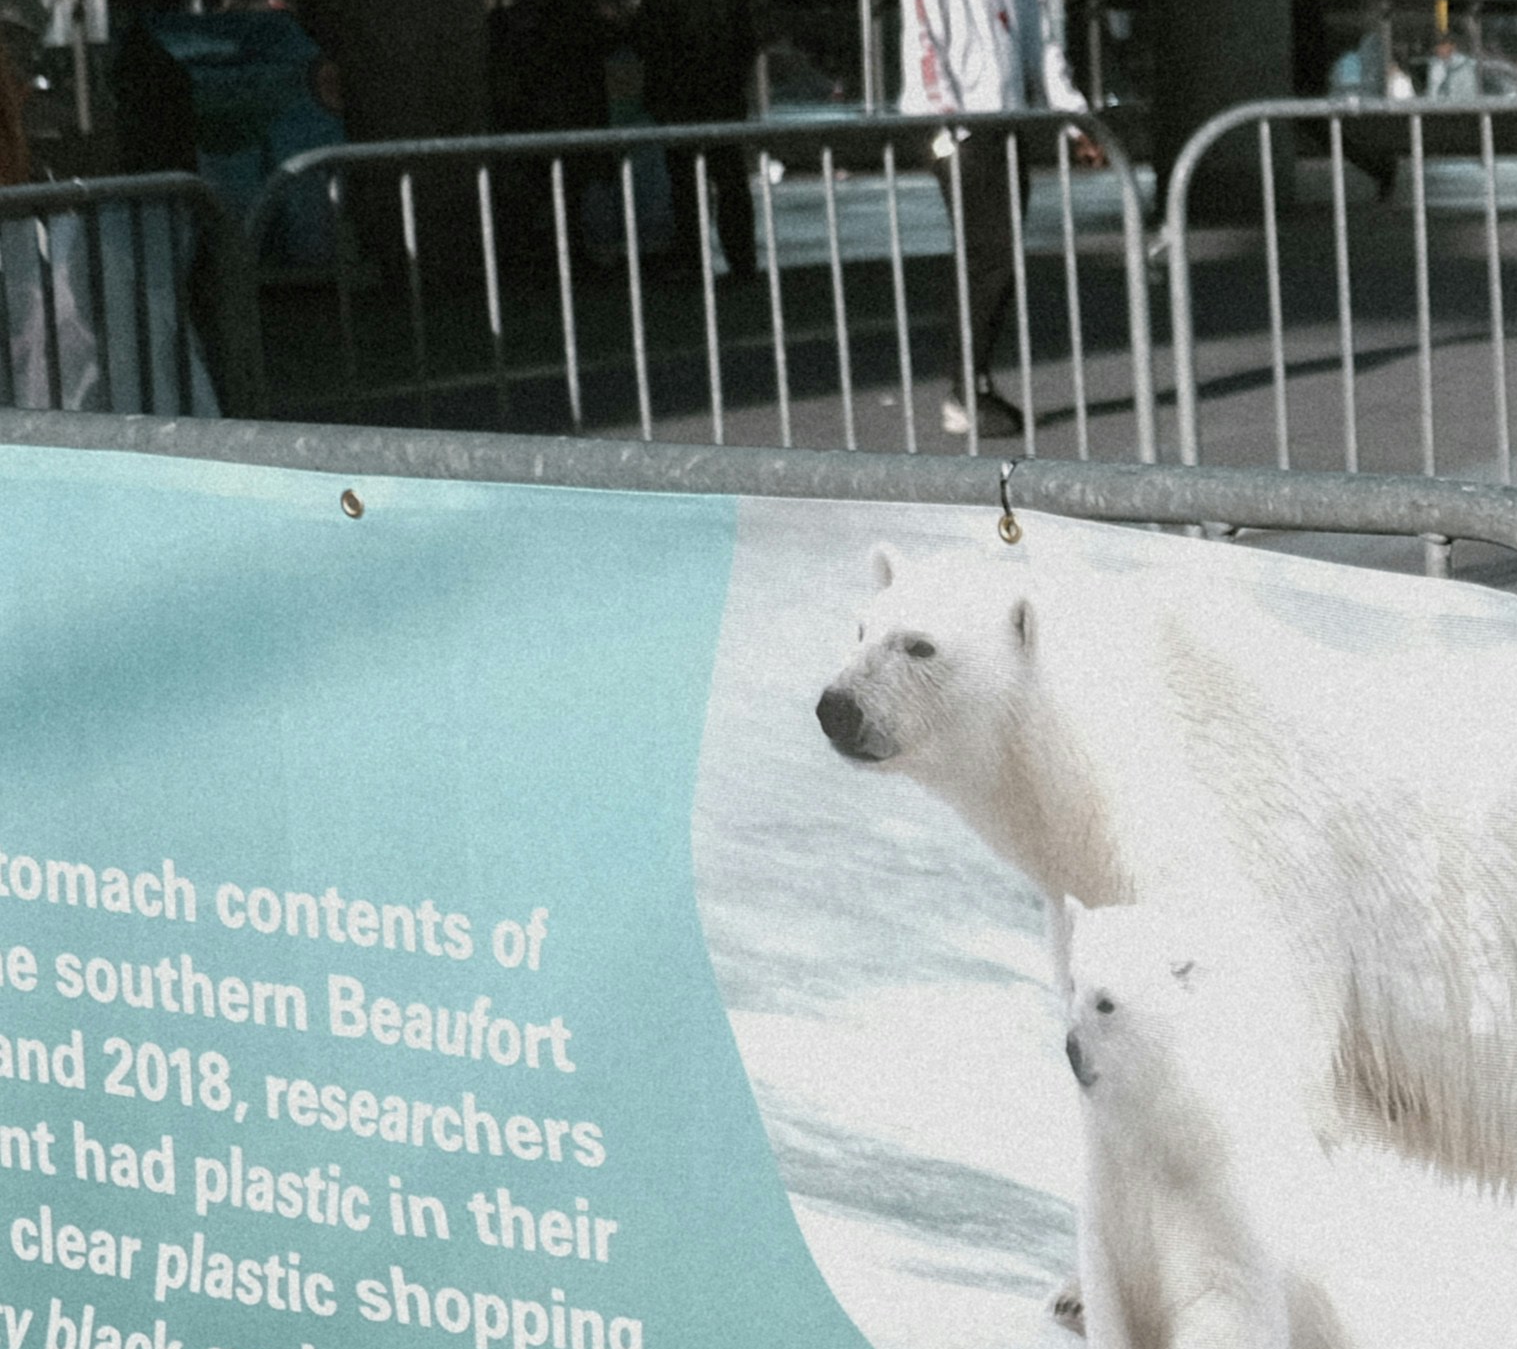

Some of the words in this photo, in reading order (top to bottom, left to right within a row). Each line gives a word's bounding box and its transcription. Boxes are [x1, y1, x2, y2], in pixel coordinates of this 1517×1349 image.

[212, 881, 477, 962] contents
[490, 905, 552, 973] of
[54, 951, 310, 1033] southern
[325, 972, 578, 1075] Beaufort
[102, 1035, 250, 1124] 2018,
[264, 1074, 608, 1169] researchers
[72, 1119, 176, 1196] had
[194, 1144, 372, 1232] plastic
[387, 1173, 451, 1241] in
[466, 1186, 621, 1264] their
[10, 1204, 142, 1280] clear
[154, 1231, 338, 1316] plastic
